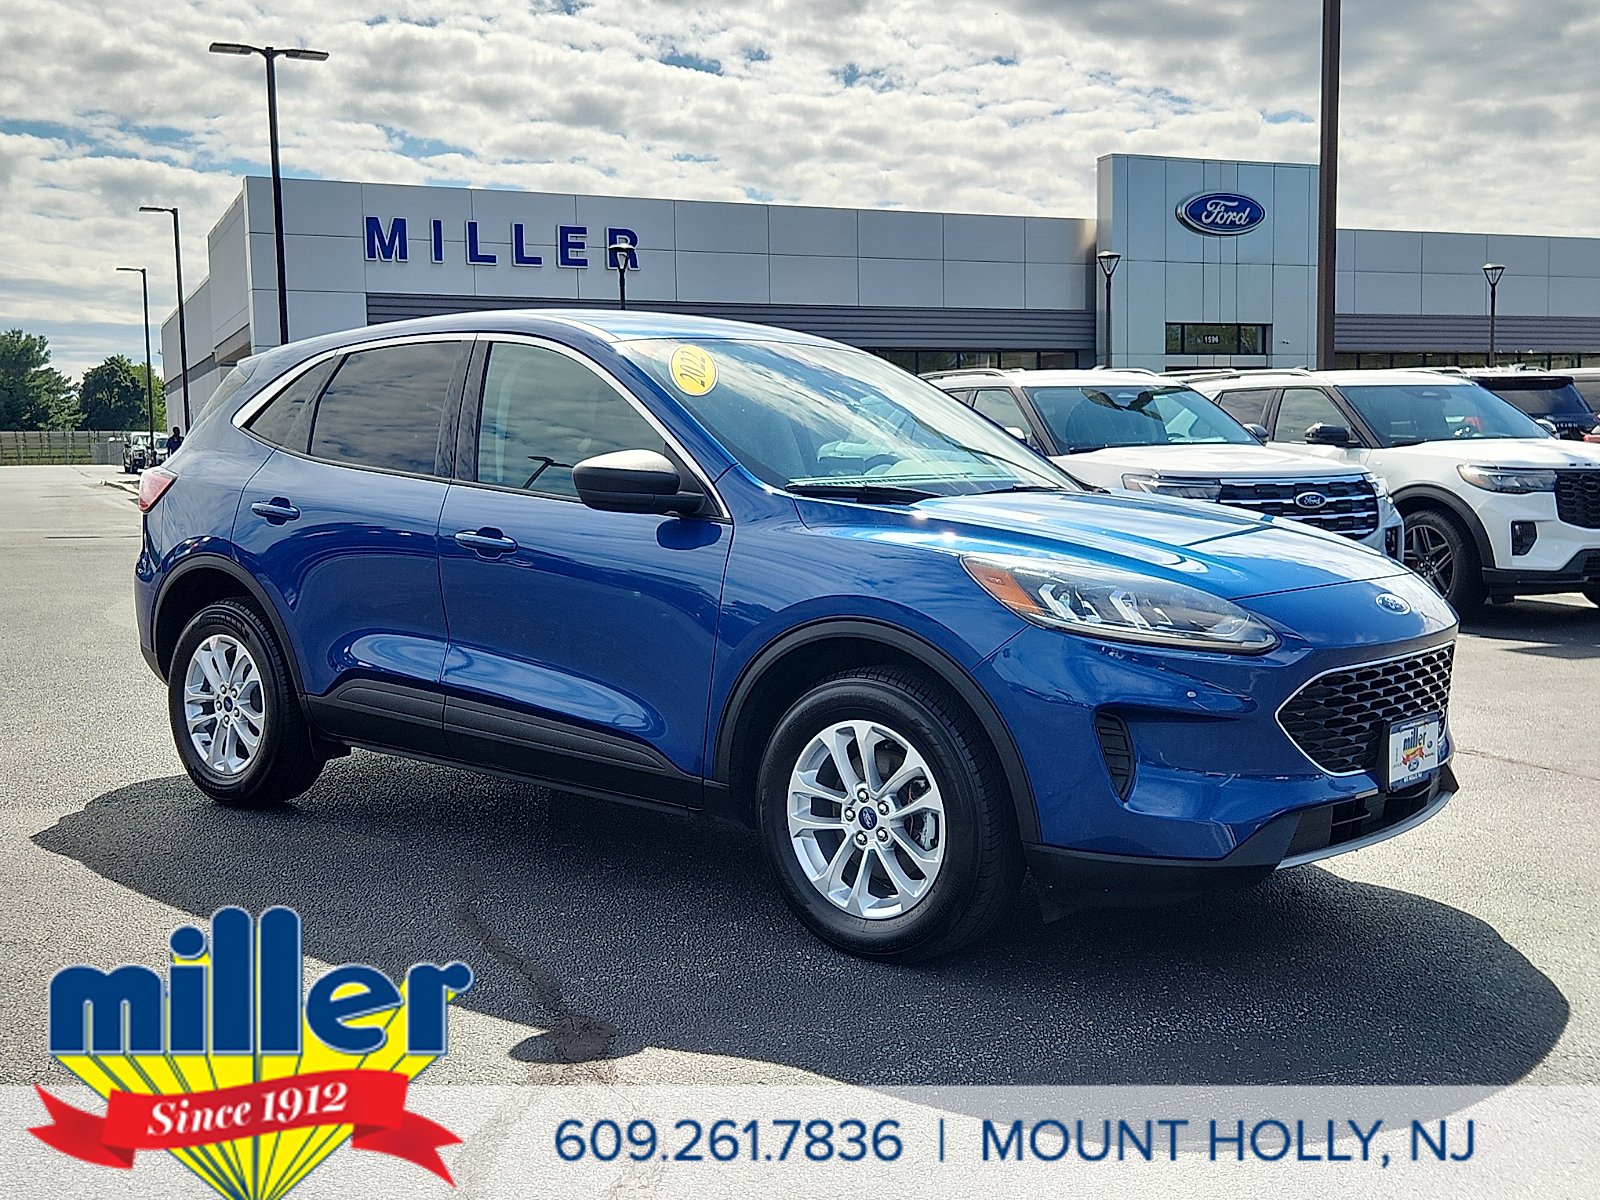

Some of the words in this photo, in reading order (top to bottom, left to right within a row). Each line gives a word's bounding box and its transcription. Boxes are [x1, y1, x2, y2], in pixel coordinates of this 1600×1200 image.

[1202, 199, 1251, 226] Ford
[363, 215, 641, 271] MILLER
[679, 350, 706, 388] 2022
